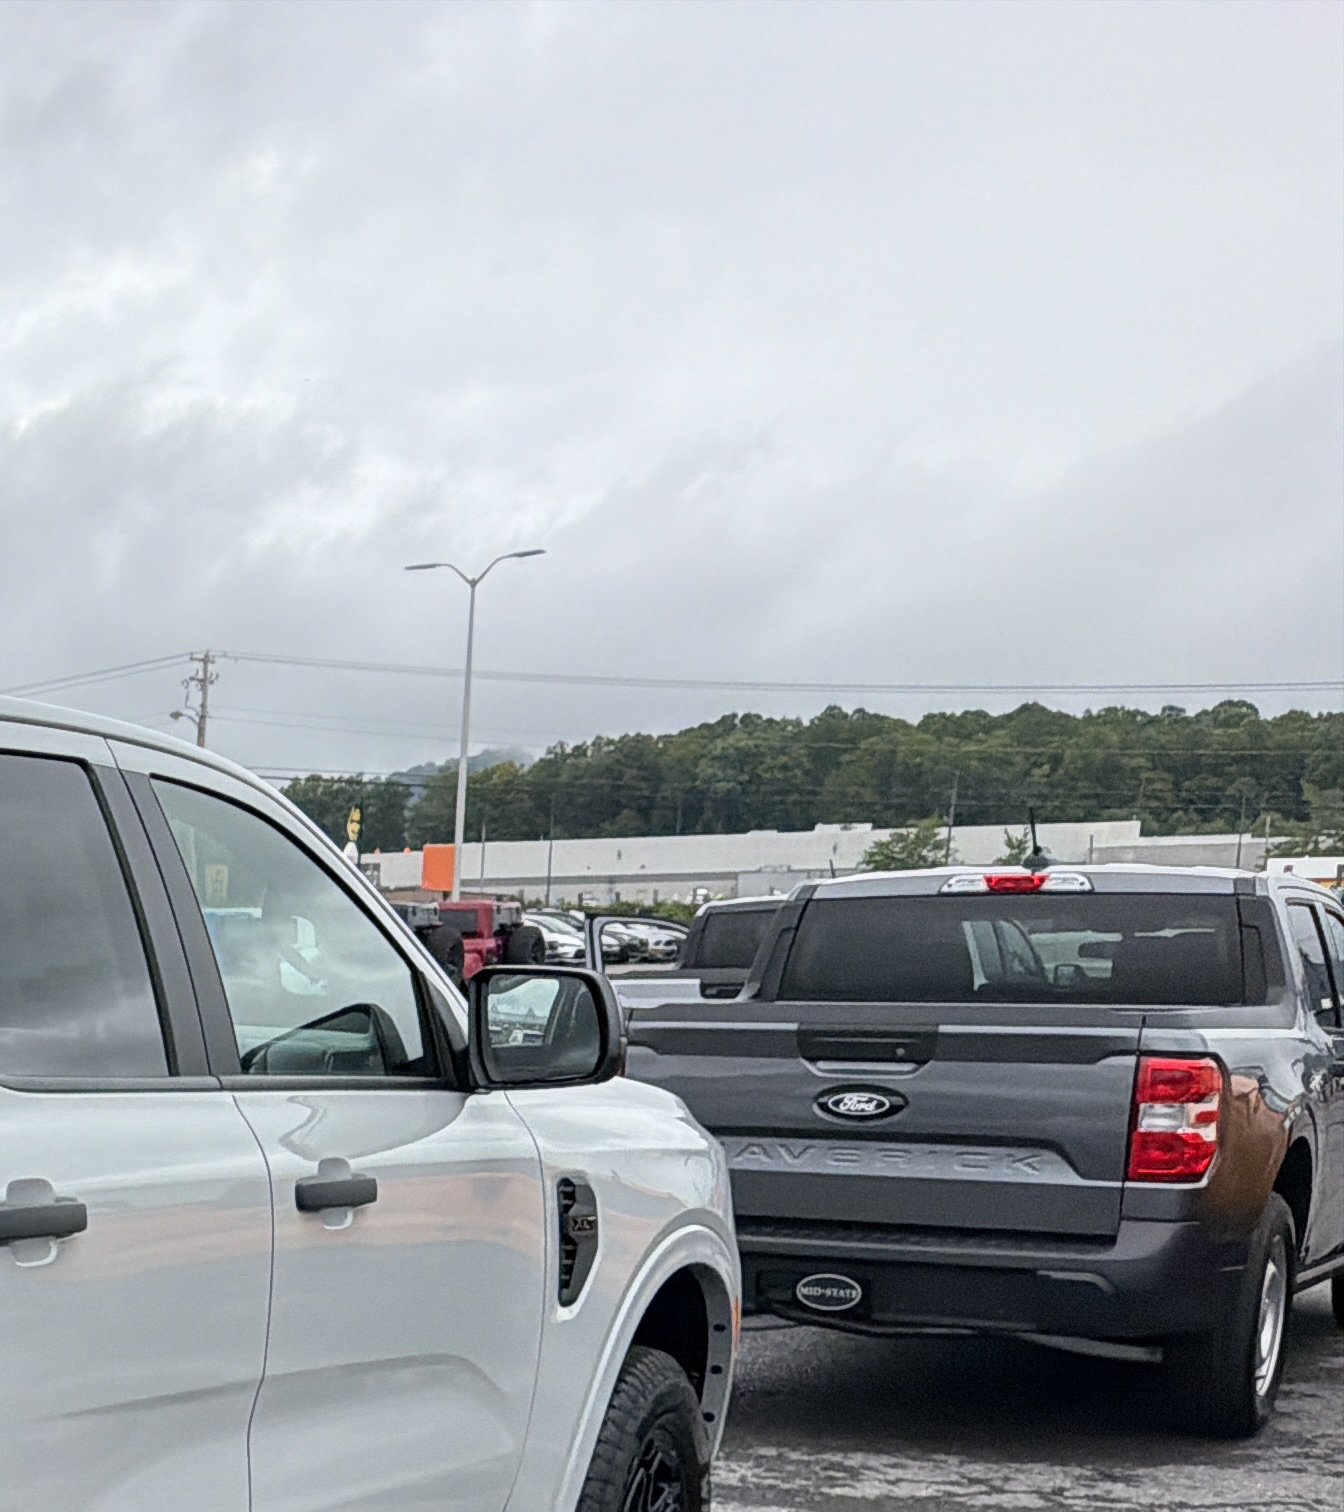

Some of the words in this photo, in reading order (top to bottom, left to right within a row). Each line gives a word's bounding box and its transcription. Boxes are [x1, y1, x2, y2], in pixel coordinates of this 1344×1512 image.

[838, 1095, 878, 1112] Ford
[722, 1141, 1042, 1176] AVERICK
[801, 1286, 858, 1299] MID-STATE
